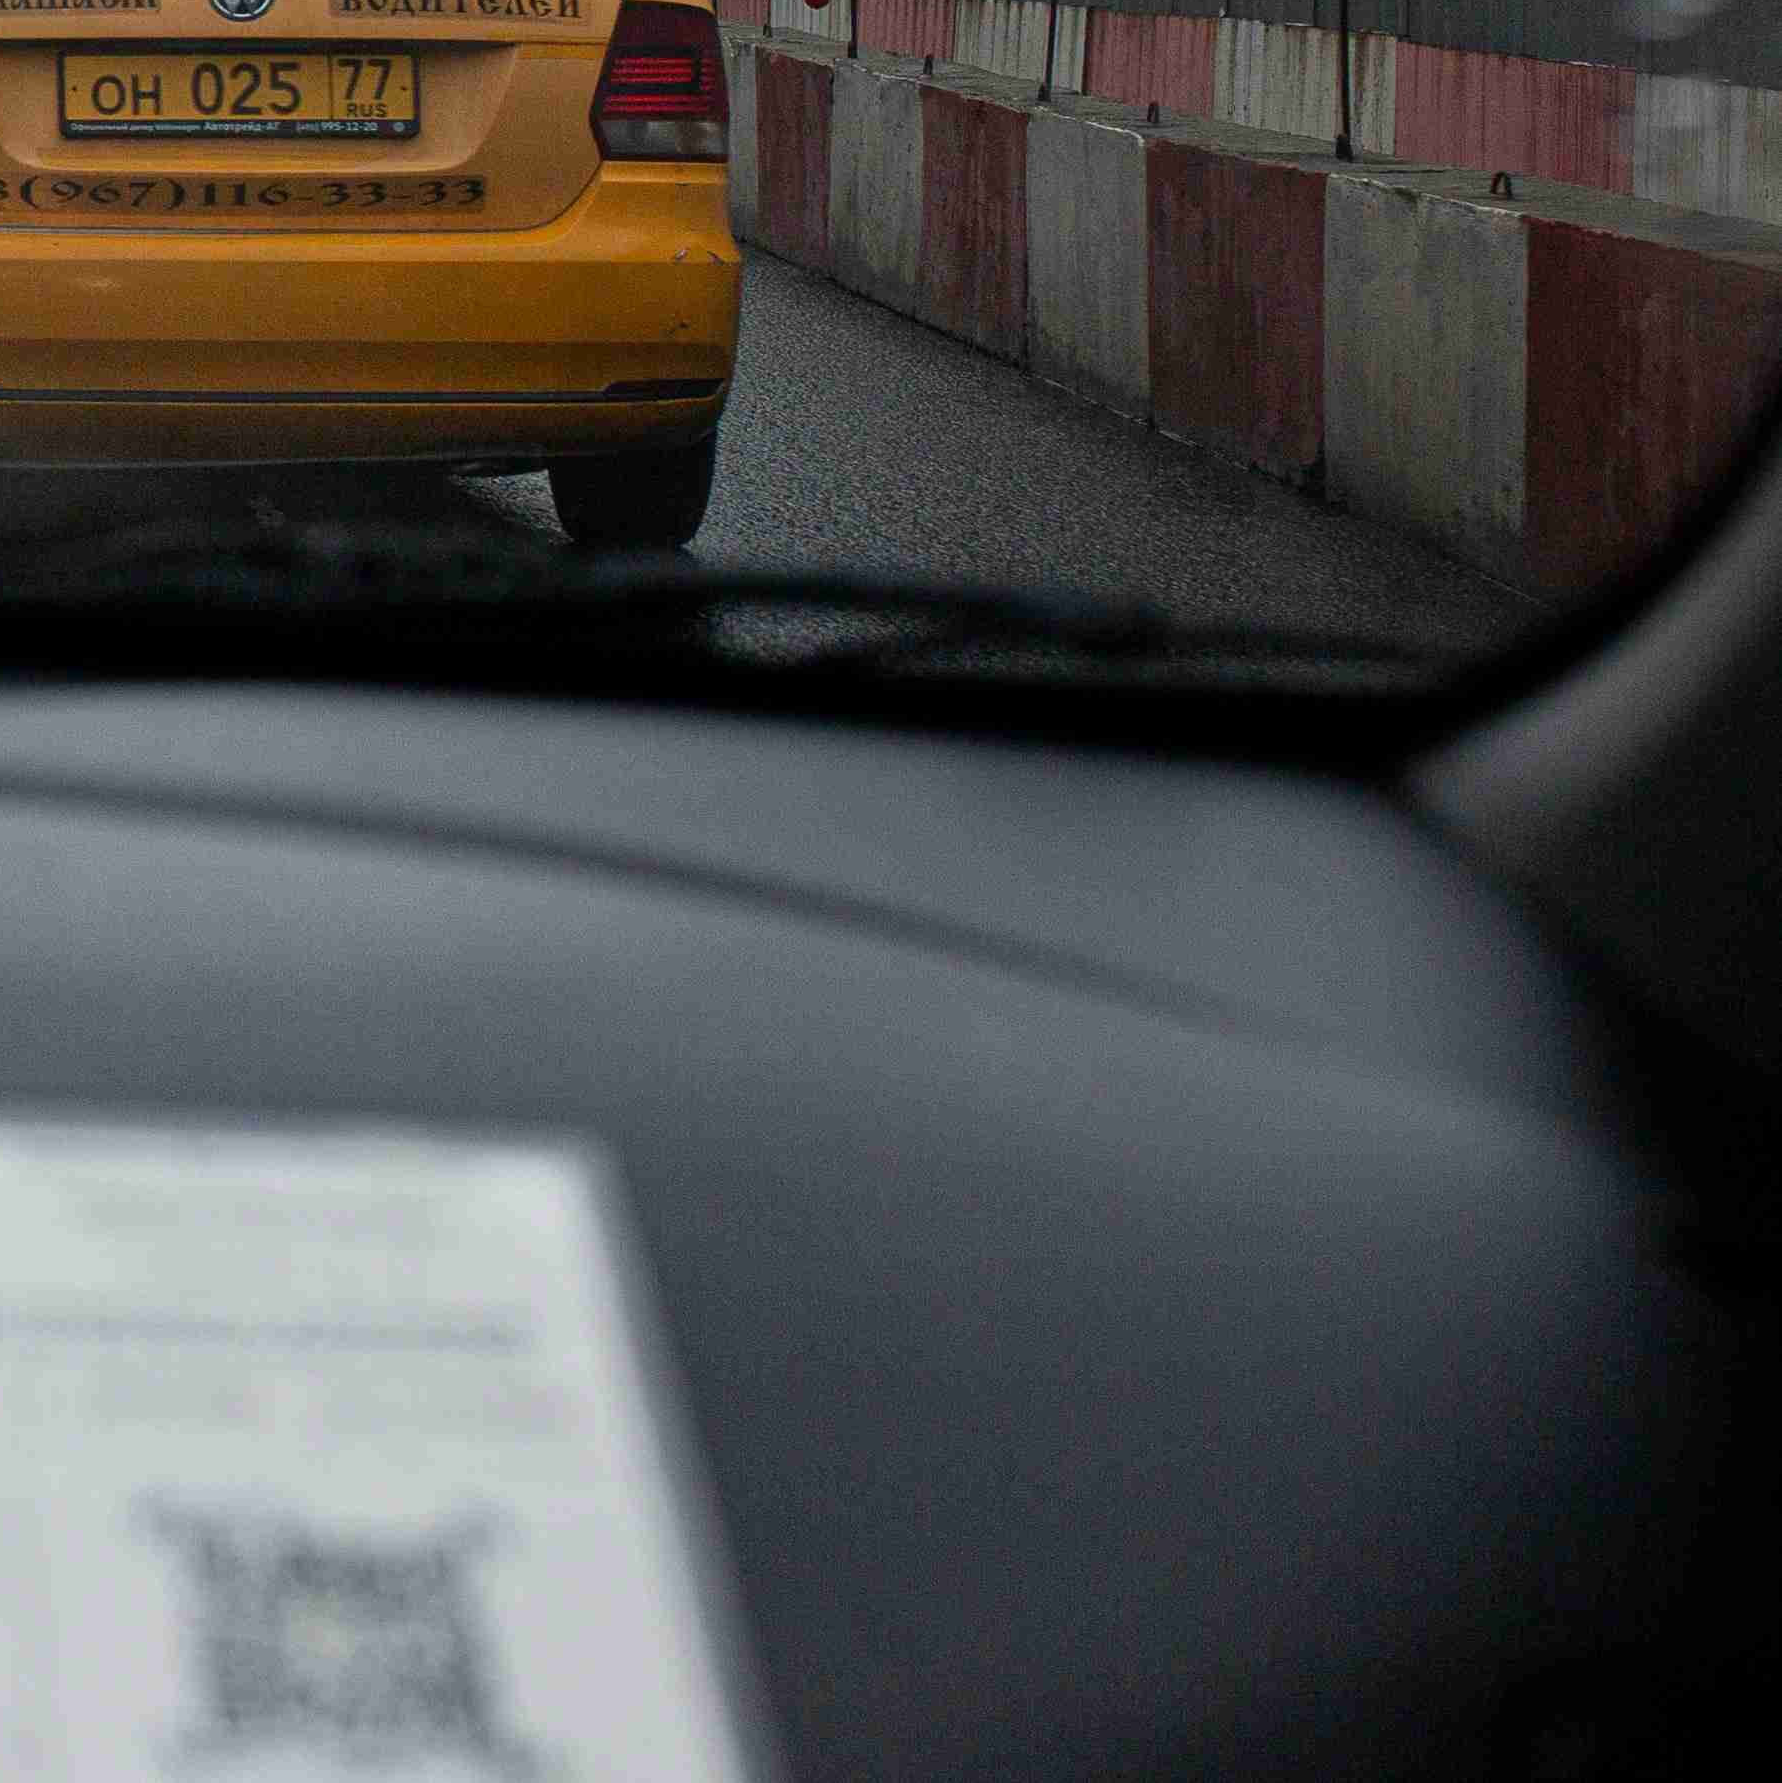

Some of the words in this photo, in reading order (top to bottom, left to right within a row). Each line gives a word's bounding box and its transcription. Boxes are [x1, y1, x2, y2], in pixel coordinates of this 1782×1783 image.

[90, 73, 162, 115] ОН
[191, 61, 302, 116] 025
[337, 58, 393, 100] 77
[346, 103, 388, 119] RUS
